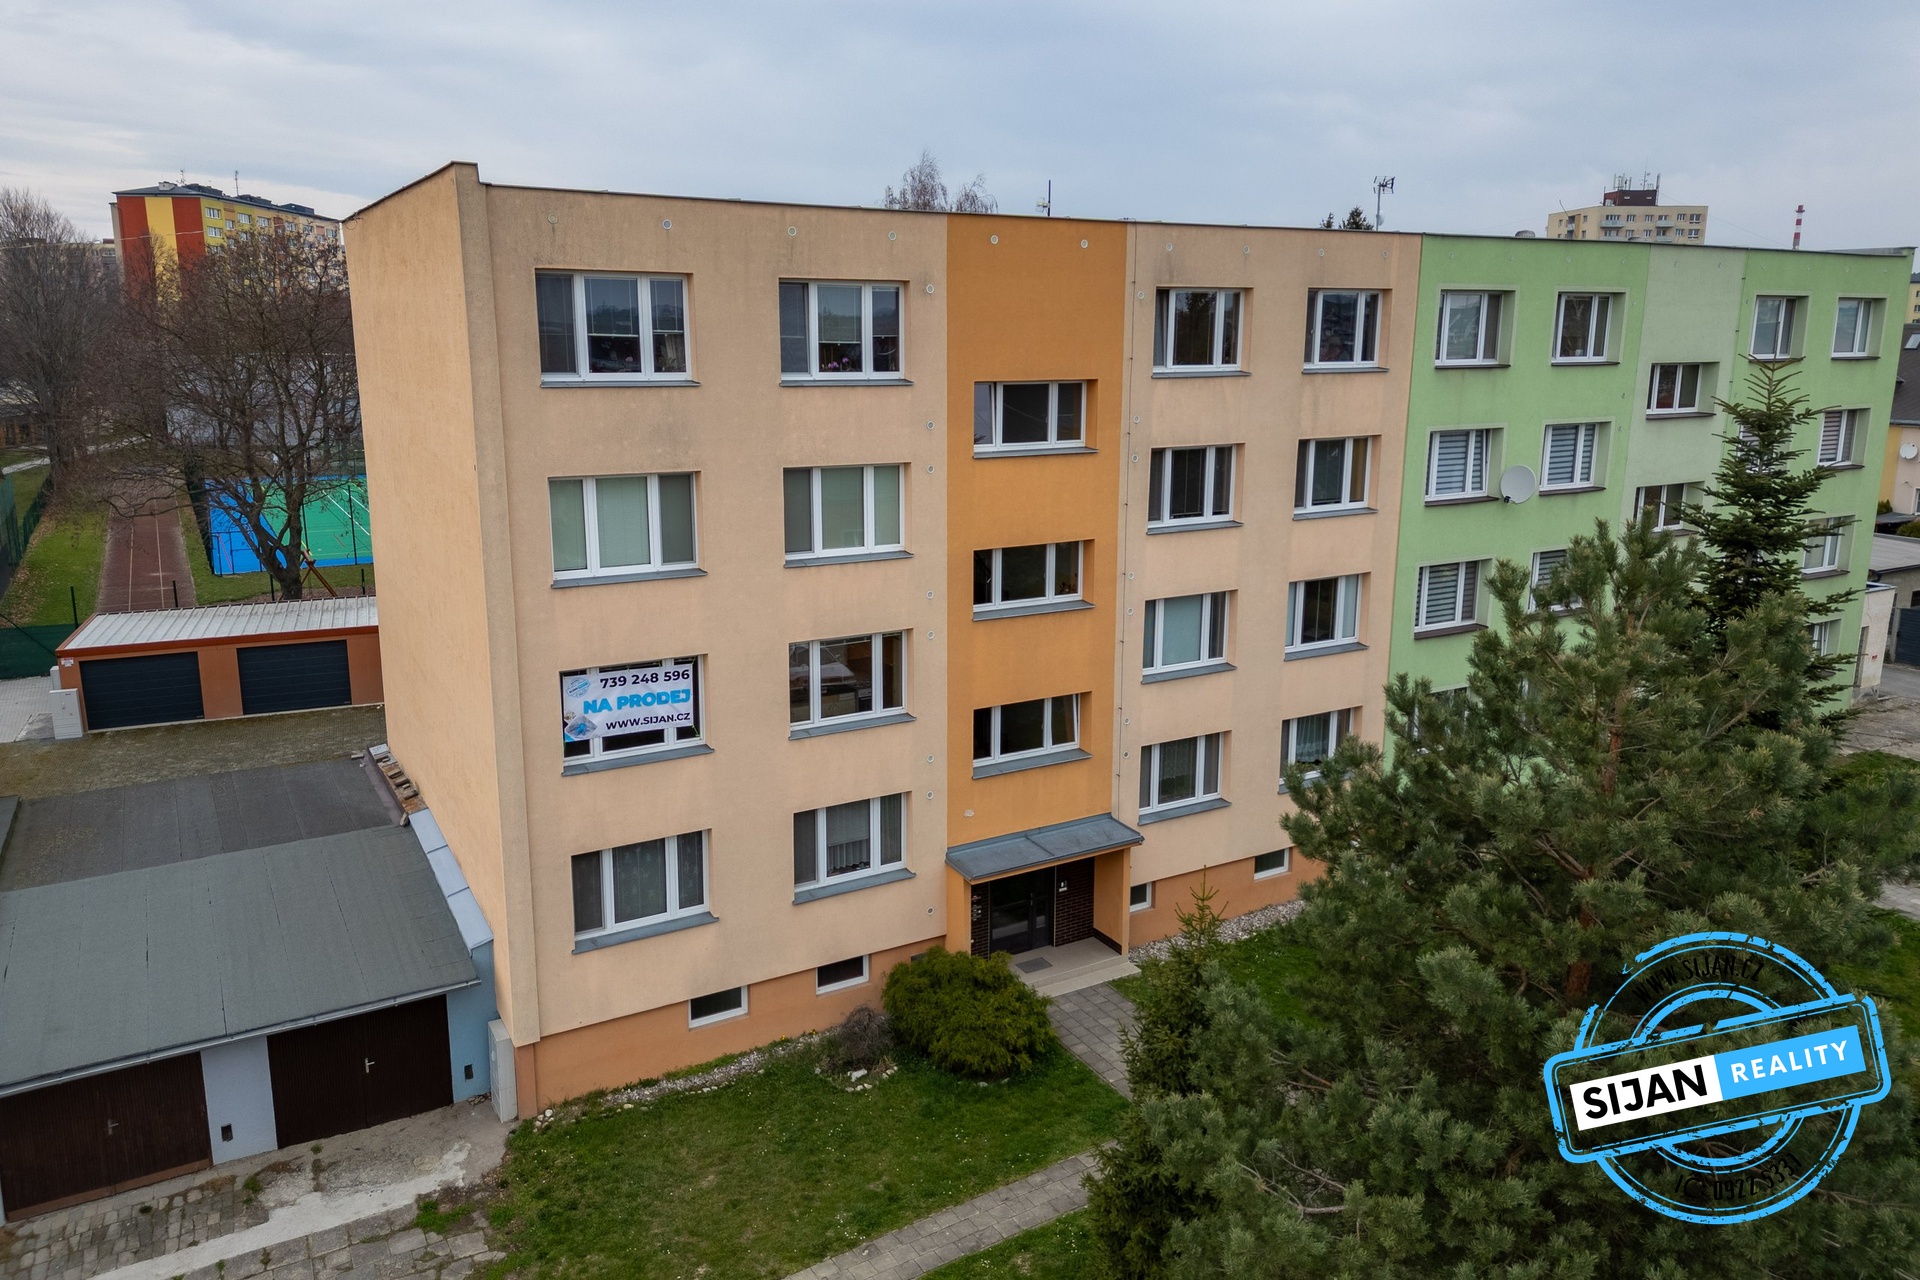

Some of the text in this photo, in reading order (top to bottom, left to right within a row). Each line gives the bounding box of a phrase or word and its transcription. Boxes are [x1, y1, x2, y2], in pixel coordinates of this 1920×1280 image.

[600, 676, 627, 689] 739
[631, 673, 659, 685] 248
[663, 669, 690, 682] 596
[583, 689, 691, 714] NA PRODEJ
[605, 712, 691, 730] WWW.SIJAN.CZ
